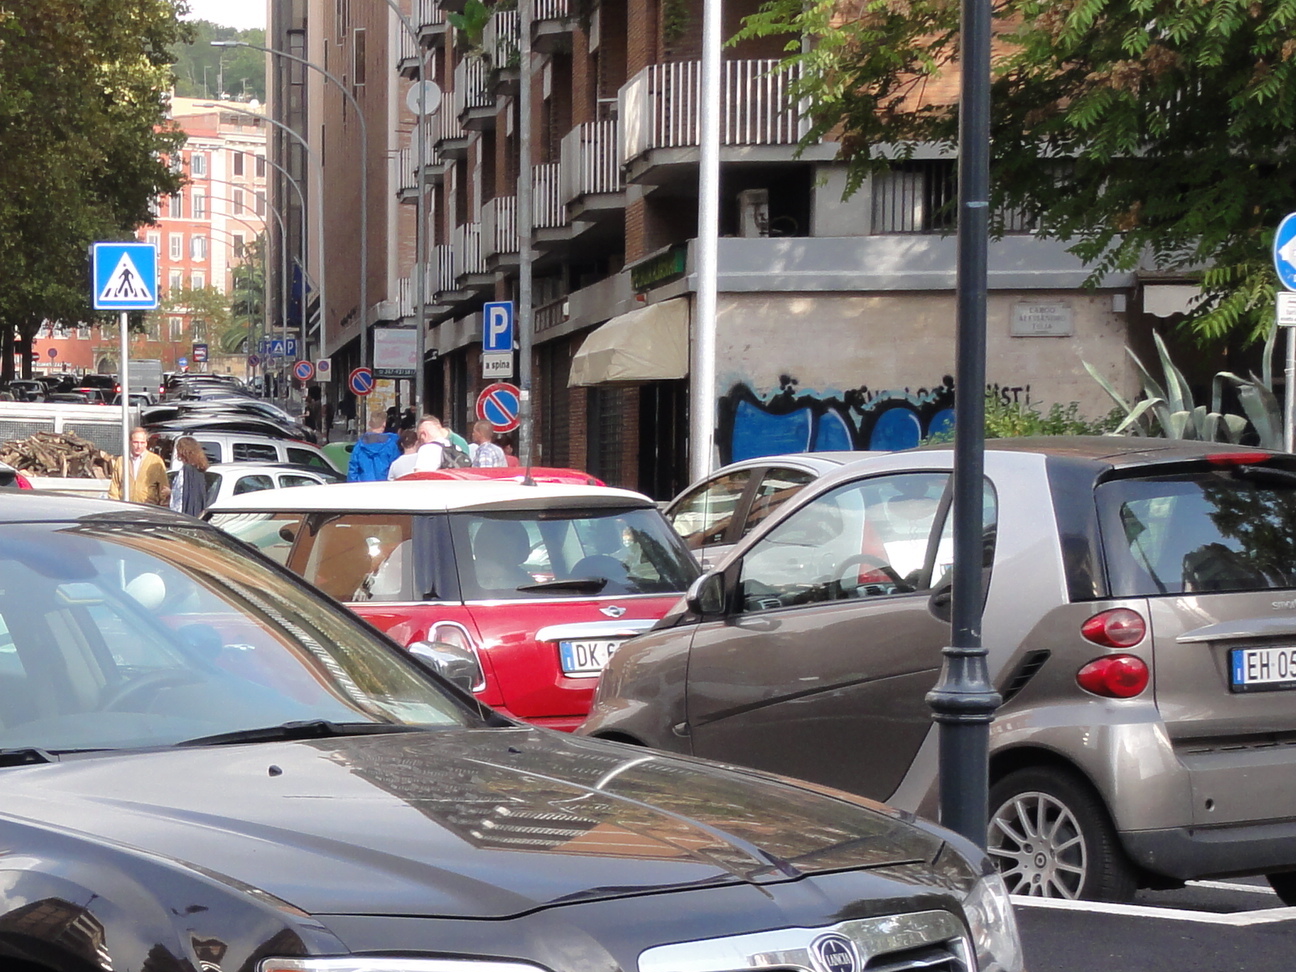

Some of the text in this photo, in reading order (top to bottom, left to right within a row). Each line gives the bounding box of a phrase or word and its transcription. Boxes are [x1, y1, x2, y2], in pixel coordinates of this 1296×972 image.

[490, 306, 508, 348] P
[287, 341, 294, 354] P
[485, 360, 510, 371] a spina
[576, 643, 601, 667] DK
[1247, 651, 1271, 680] EH
[825, 952, 852, 967] LANCIA
